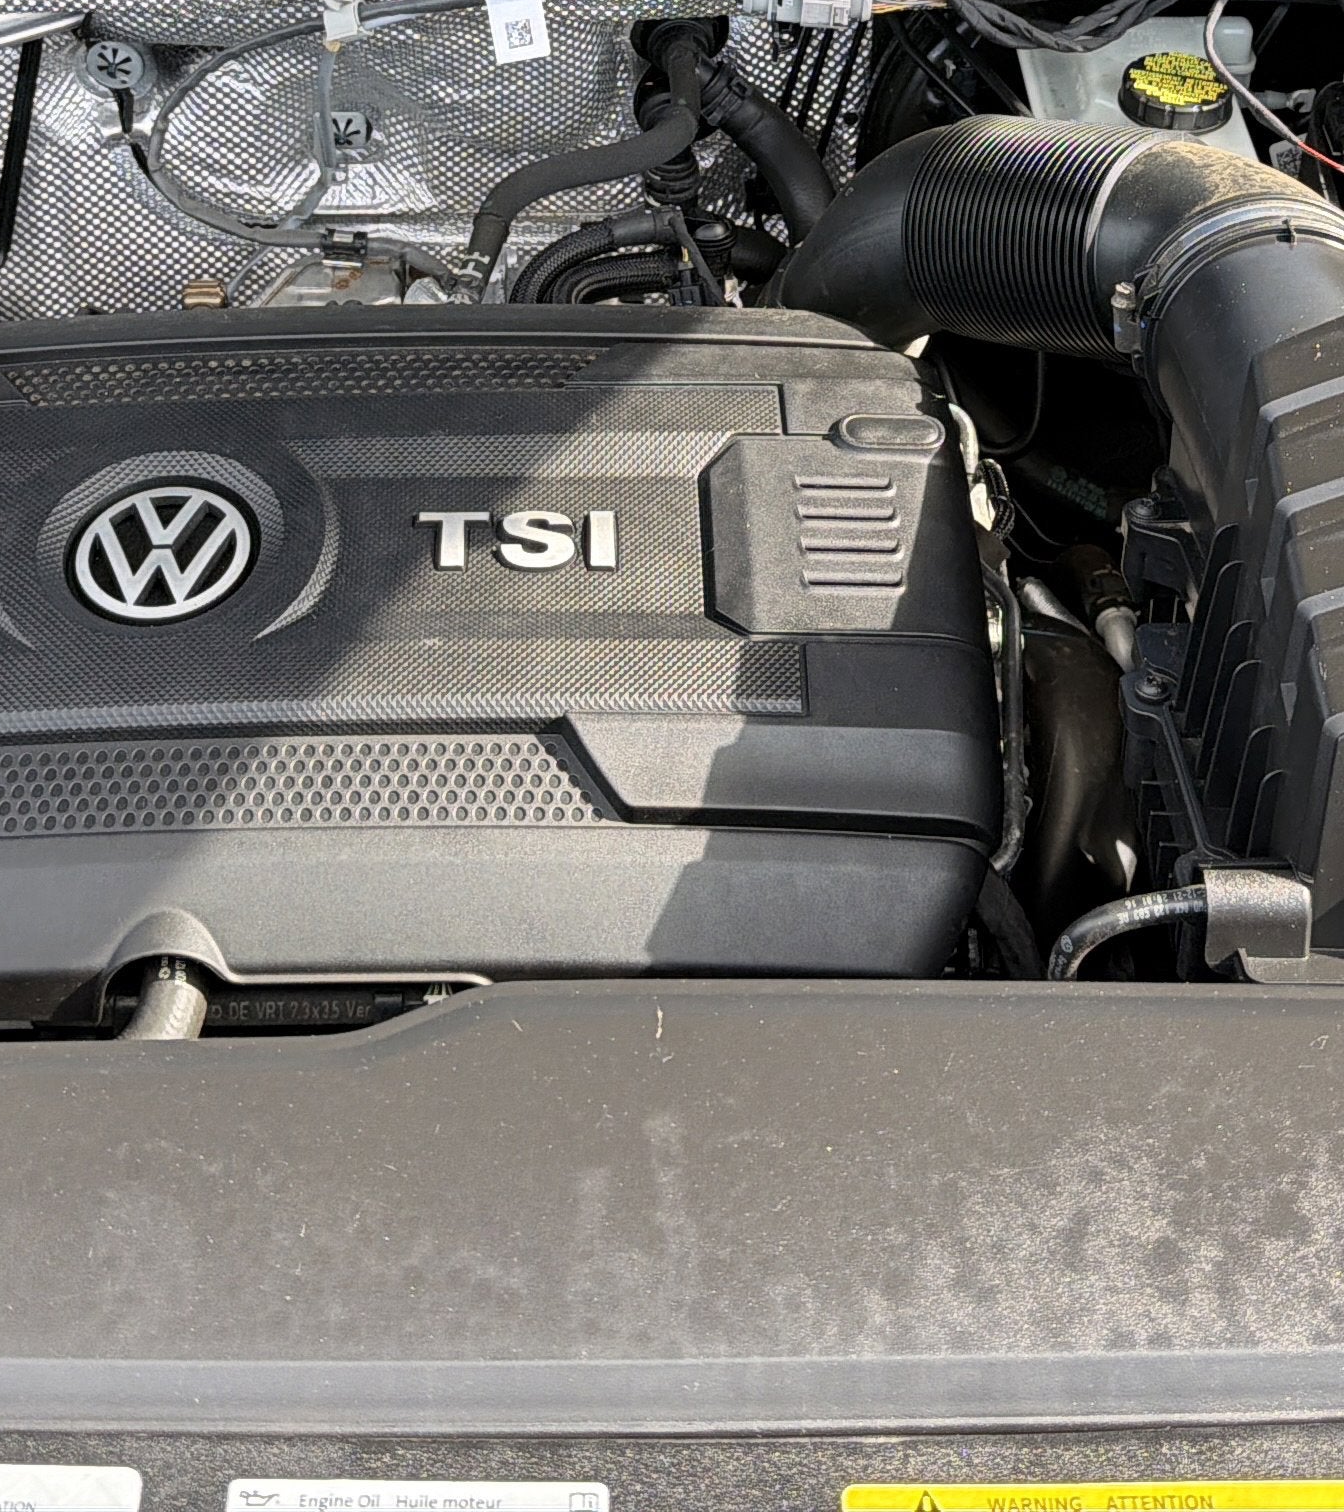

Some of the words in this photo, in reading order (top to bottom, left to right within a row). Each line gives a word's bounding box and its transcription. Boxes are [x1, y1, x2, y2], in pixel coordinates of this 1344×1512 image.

[415, 510, 619, 572] TSI
[299, 1494, 354, 1512] Engine
[358, 1494, 381, 1508] Oil
[395, 1495, 439, 1509] Huile
[443, 1496, 503, 1509] moteur
[987, 1496, 1083, 1512] WARNING
[1106, 1494, 1215, 1511] ATTENTION
